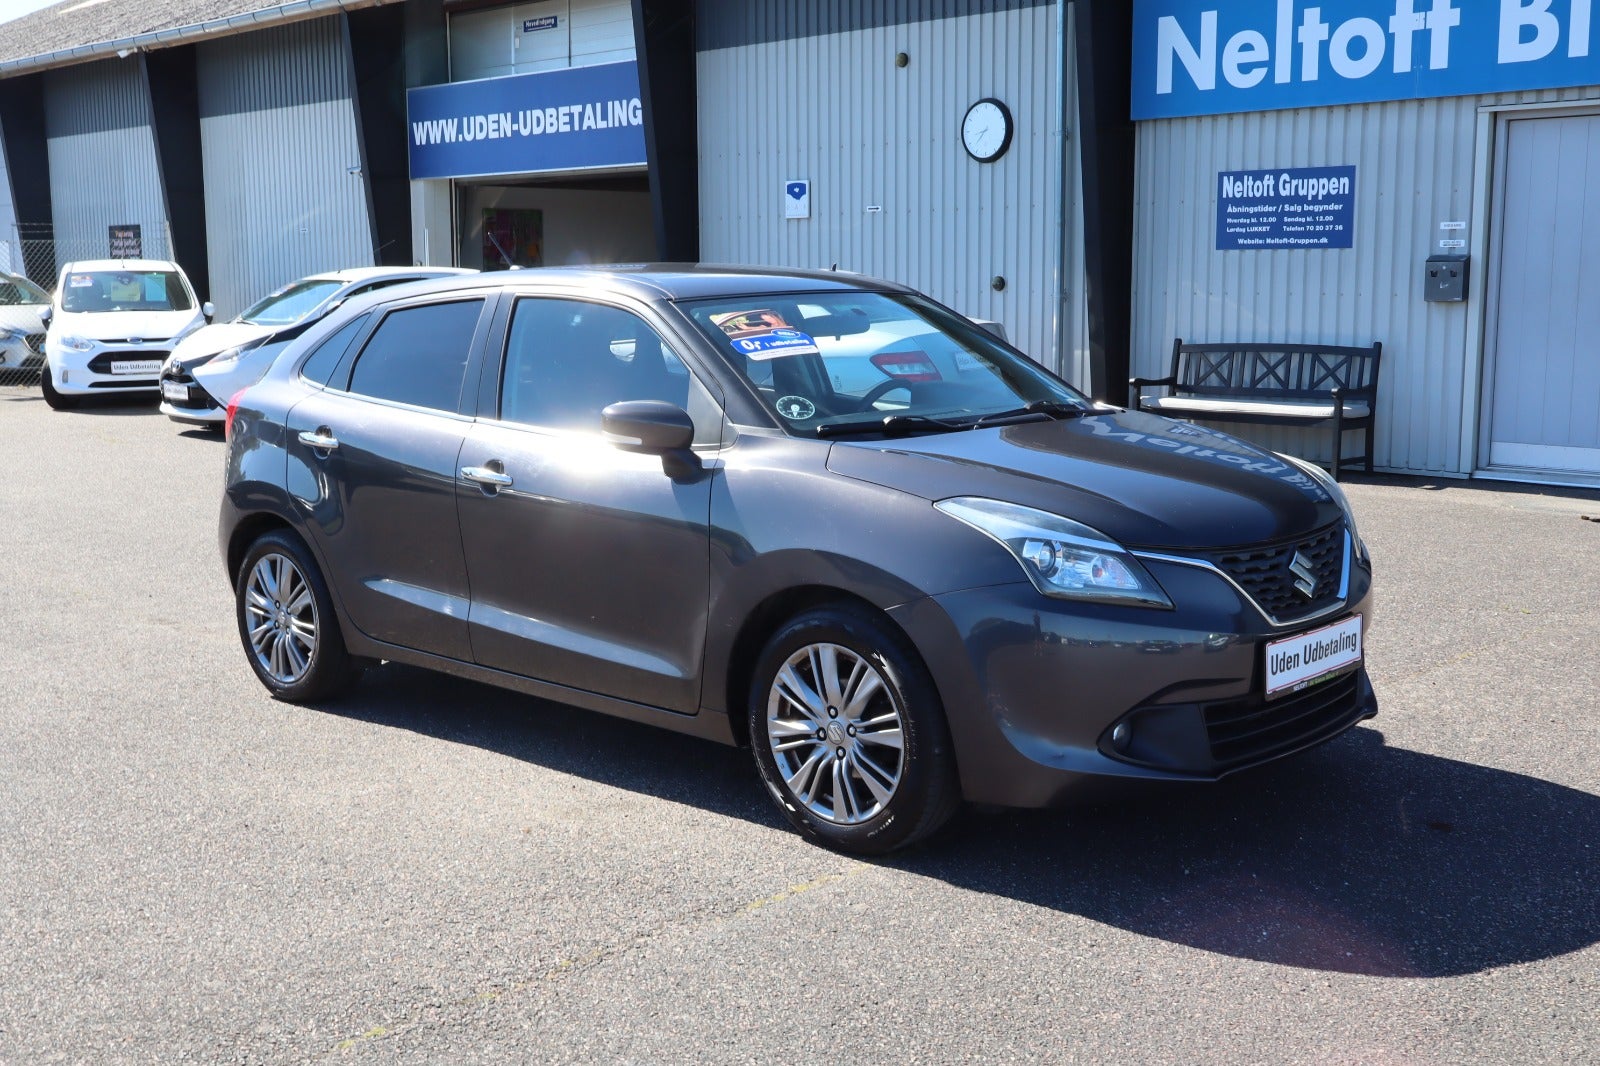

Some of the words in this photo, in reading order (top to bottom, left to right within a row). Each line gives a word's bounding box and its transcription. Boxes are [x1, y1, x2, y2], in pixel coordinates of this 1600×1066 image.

[413, 98, 643, 146] WWW.UDEN-UDBETALING
[1222, 174, 1275, 199] Neltoft
[1278, 173, 1350, 201] Gruppen
[1226, 204, 1277, 214] Åbningstider
[1284, 203, 1302, 213] Salg
[1303, 202, 1344, 212] begynder
[1271, 651, 1300, 676] Uden
[1303, 631, 1358, 665] Udbetaling
